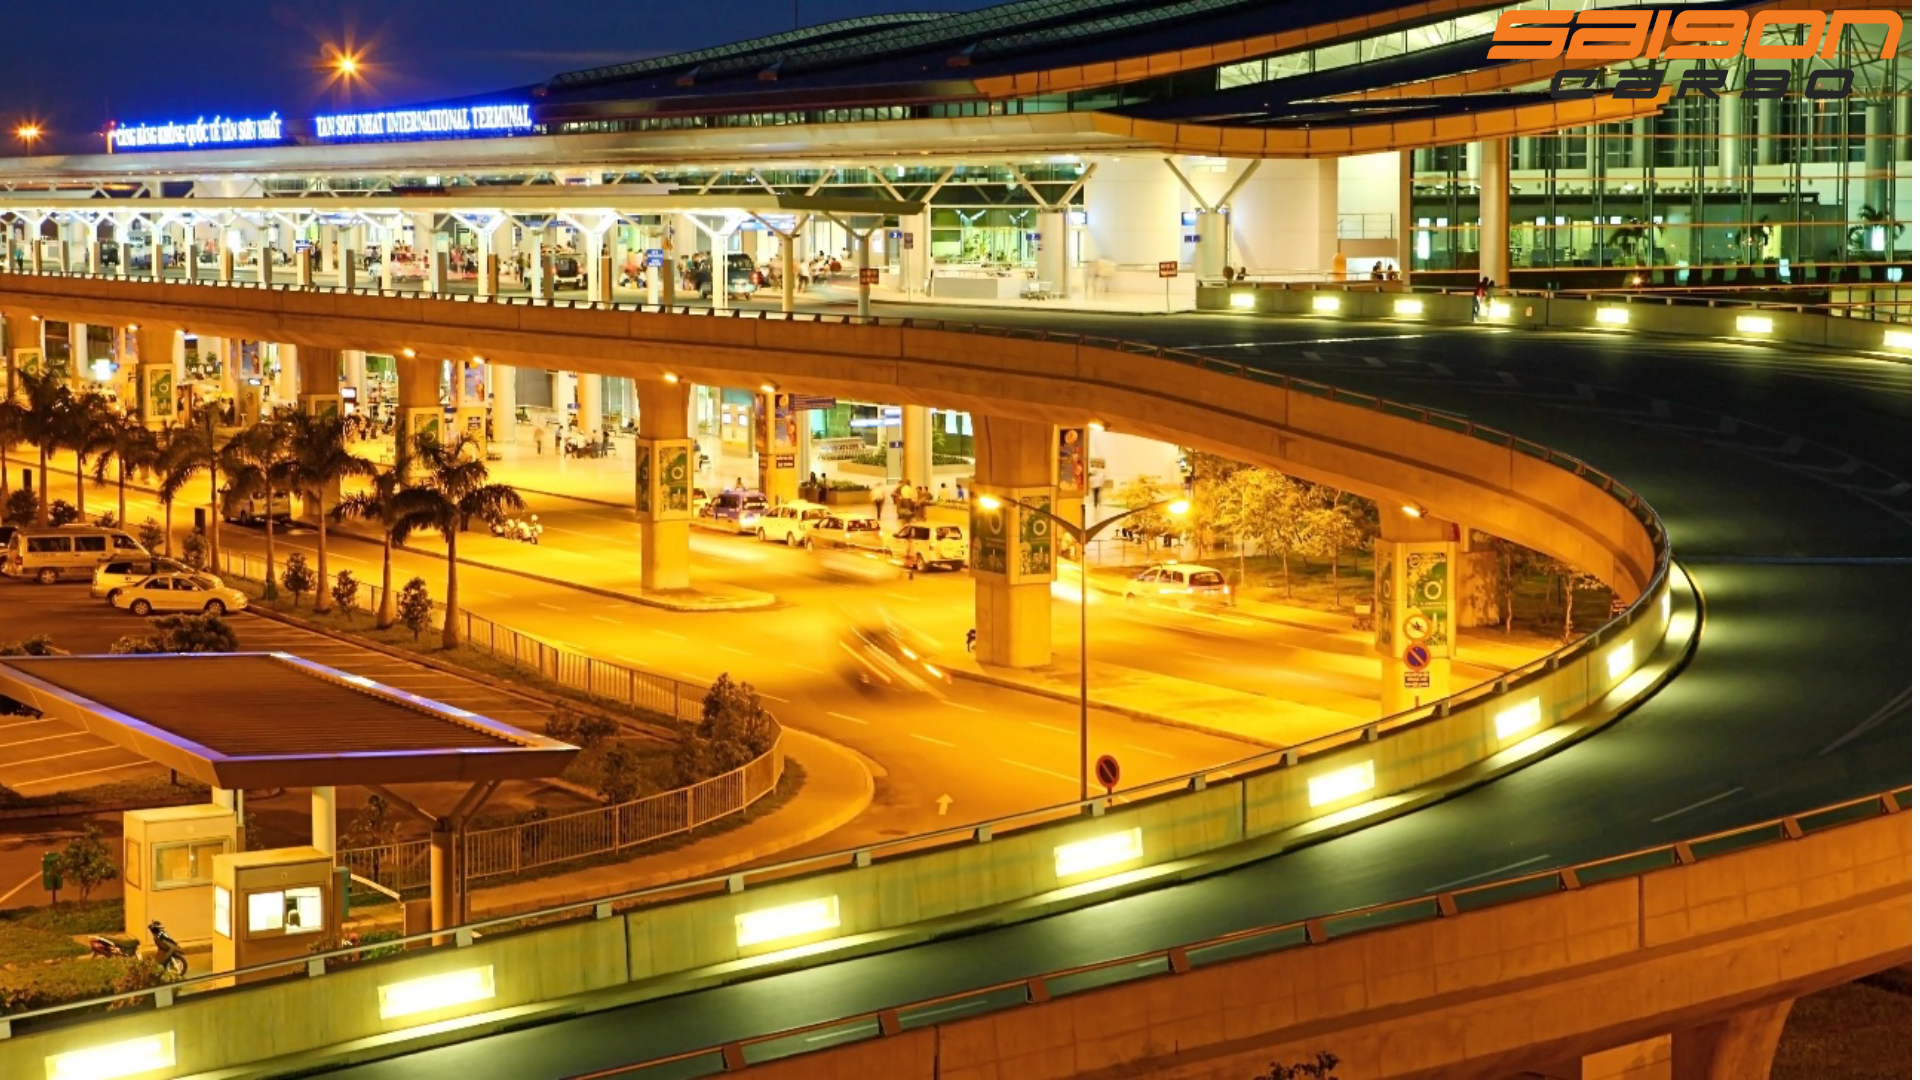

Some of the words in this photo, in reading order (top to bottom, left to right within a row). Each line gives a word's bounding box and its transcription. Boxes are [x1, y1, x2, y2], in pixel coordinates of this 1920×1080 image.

[316, 116, 335, 137] TAN
[336, 114, 356, 136] SON
[357, 112, 385, 134] NHAT
[386, 108, 470, 132] INTERNATIONAL
[471, 104, 532, 129] TERMINAL
